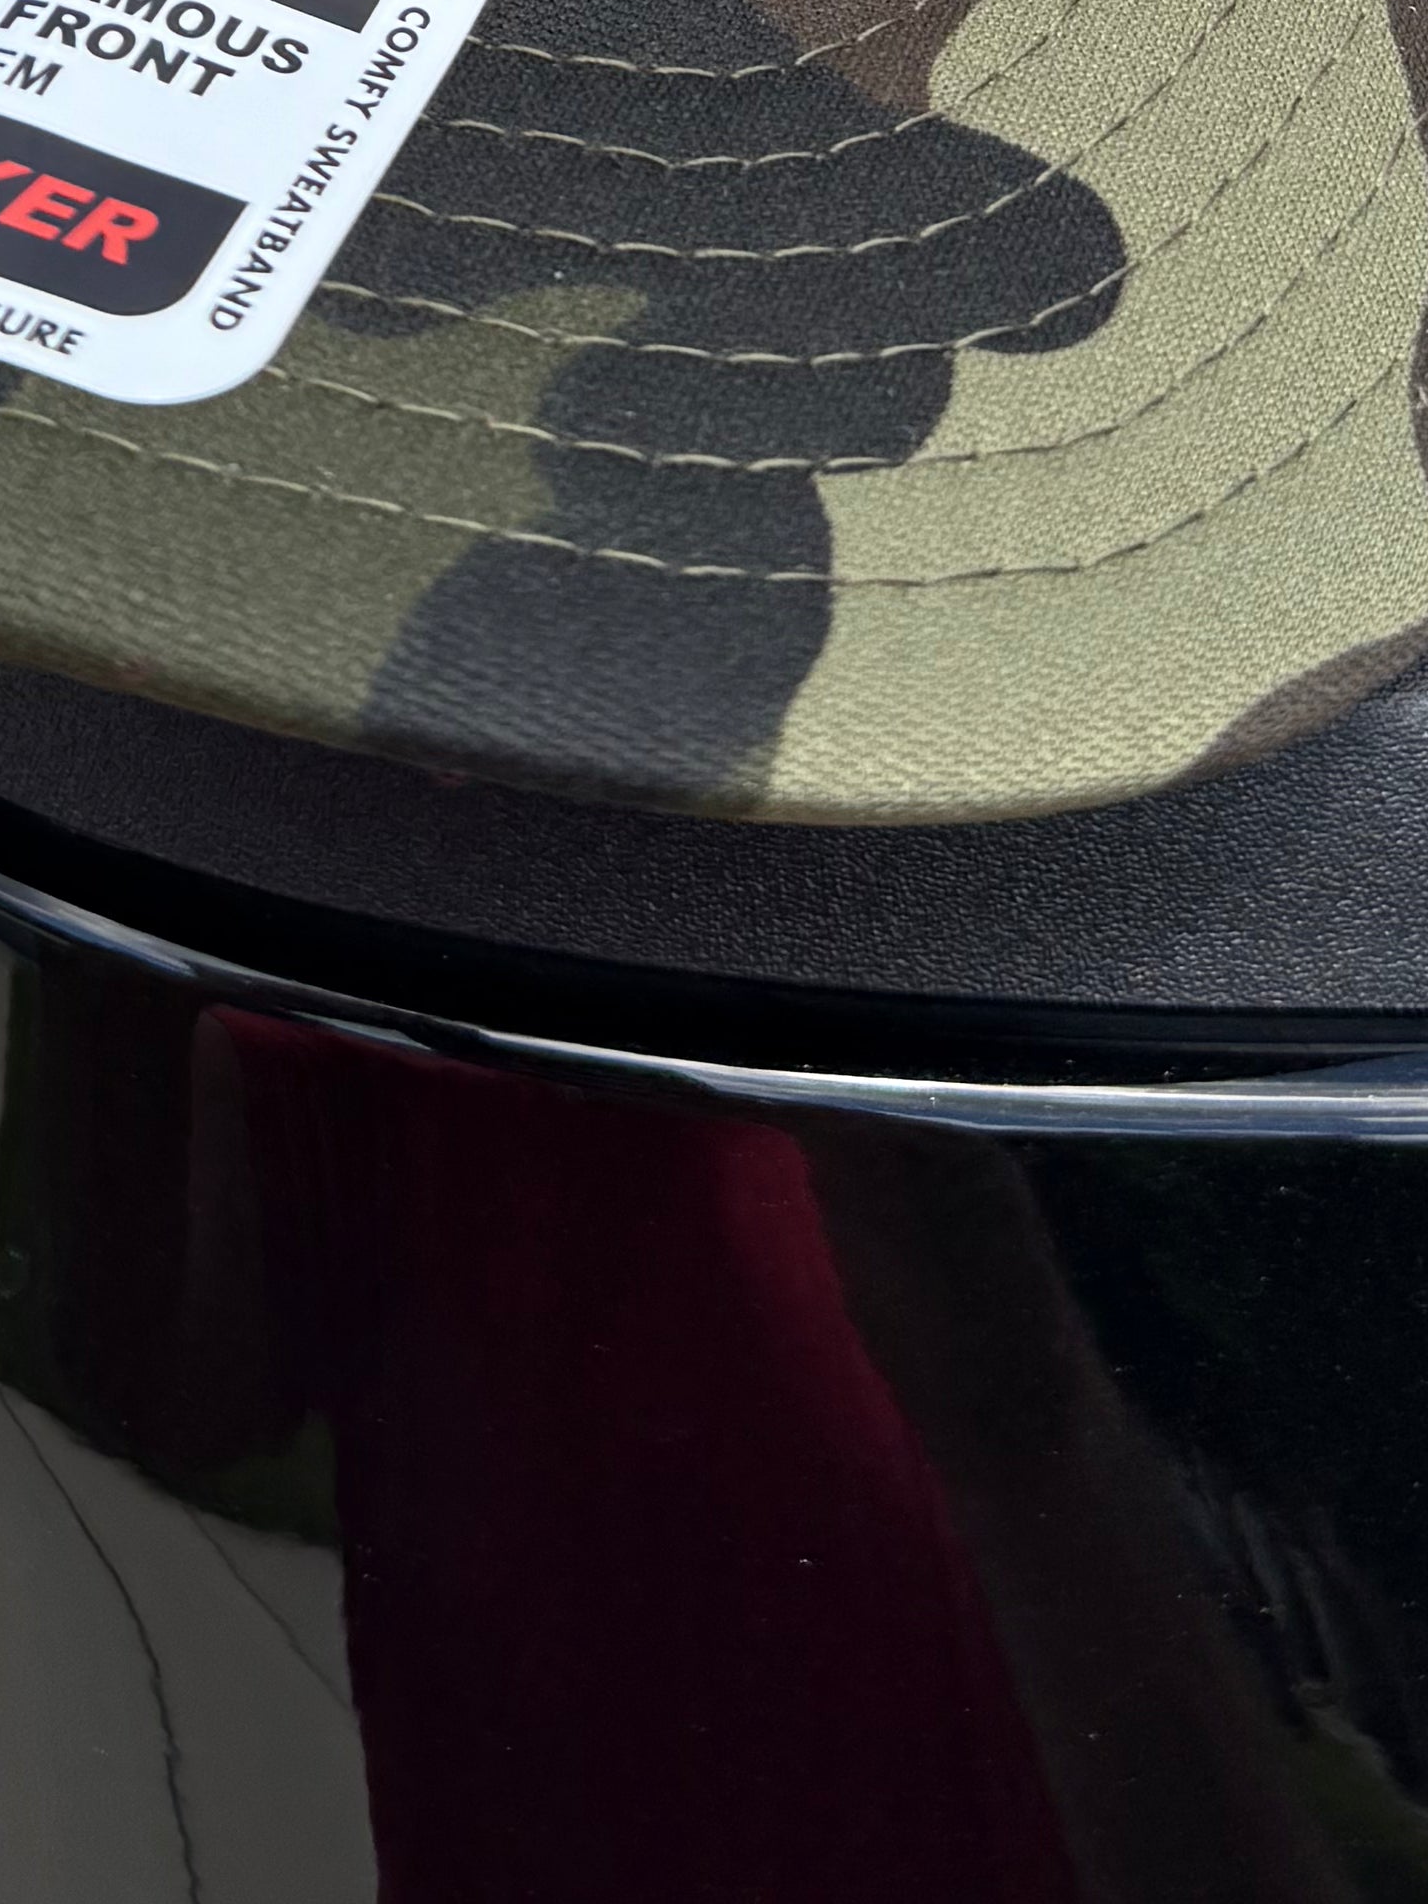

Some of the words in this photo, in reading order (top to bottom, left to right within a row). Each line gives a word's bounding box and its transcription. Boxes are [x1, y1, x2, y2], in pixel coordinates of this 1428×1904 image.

[0, 0, 237, 98] FRONT
[345, 7, 433, 122] COMFY
[209, 123, 360, 333] SWEATBAND
